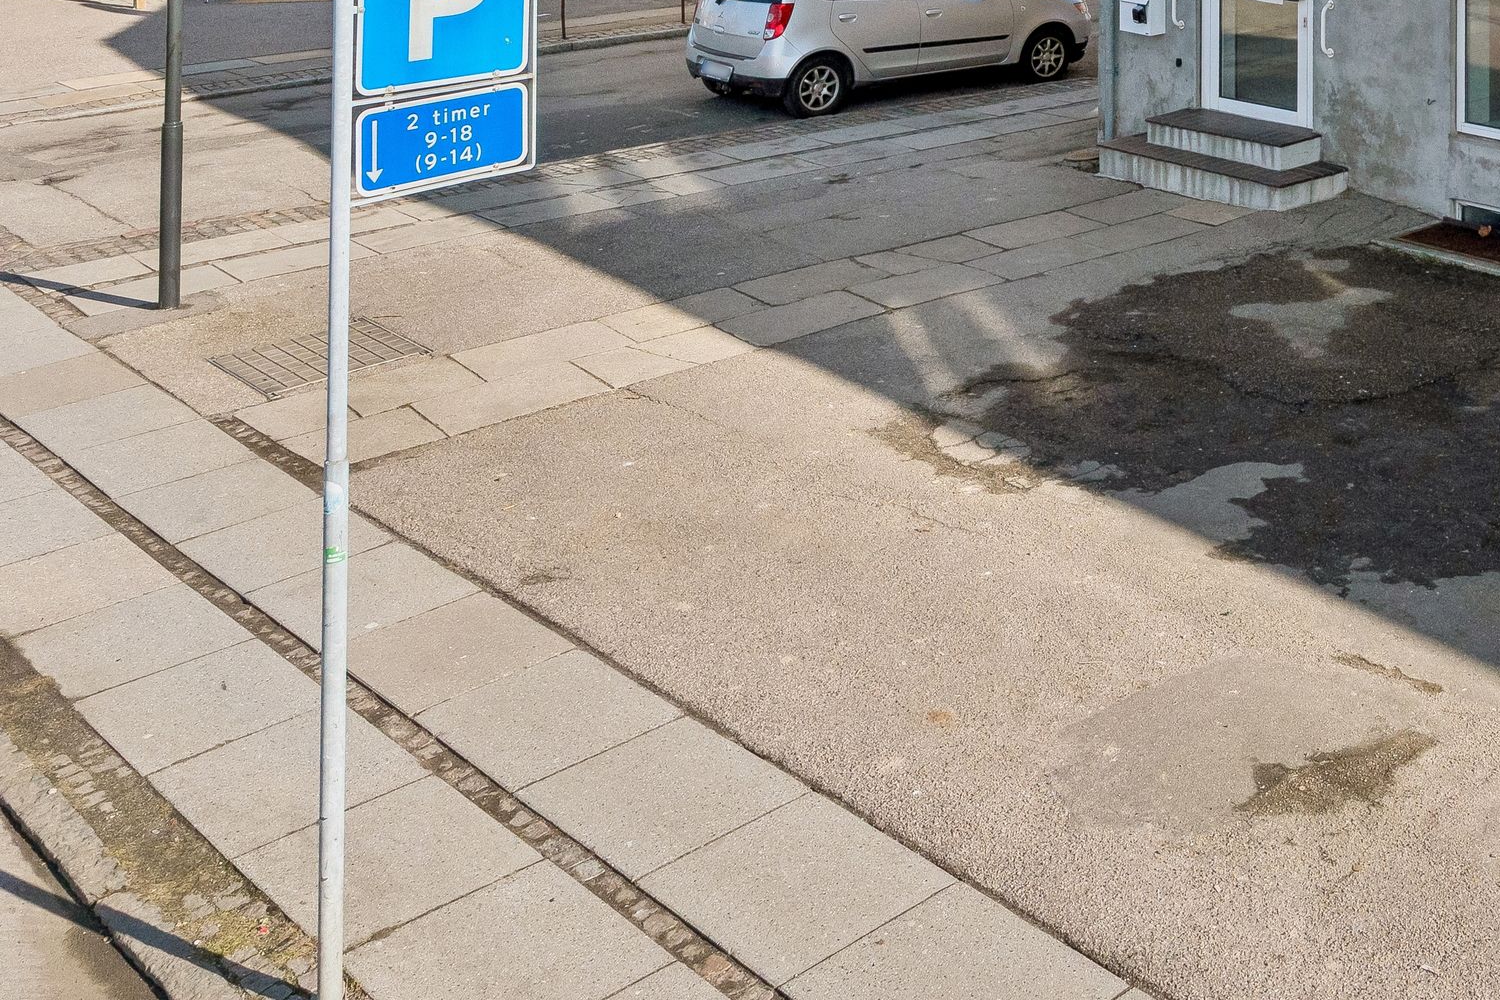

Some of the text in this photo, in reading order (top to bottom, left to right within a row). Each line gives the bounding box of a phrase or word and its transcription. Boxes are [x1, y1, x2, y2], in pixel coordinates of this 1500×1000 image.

[406, 103, 491, 131] 2 timer
[424, 124, 473, 149] 9-18
[415, 142, 482, 174] (9-14)
